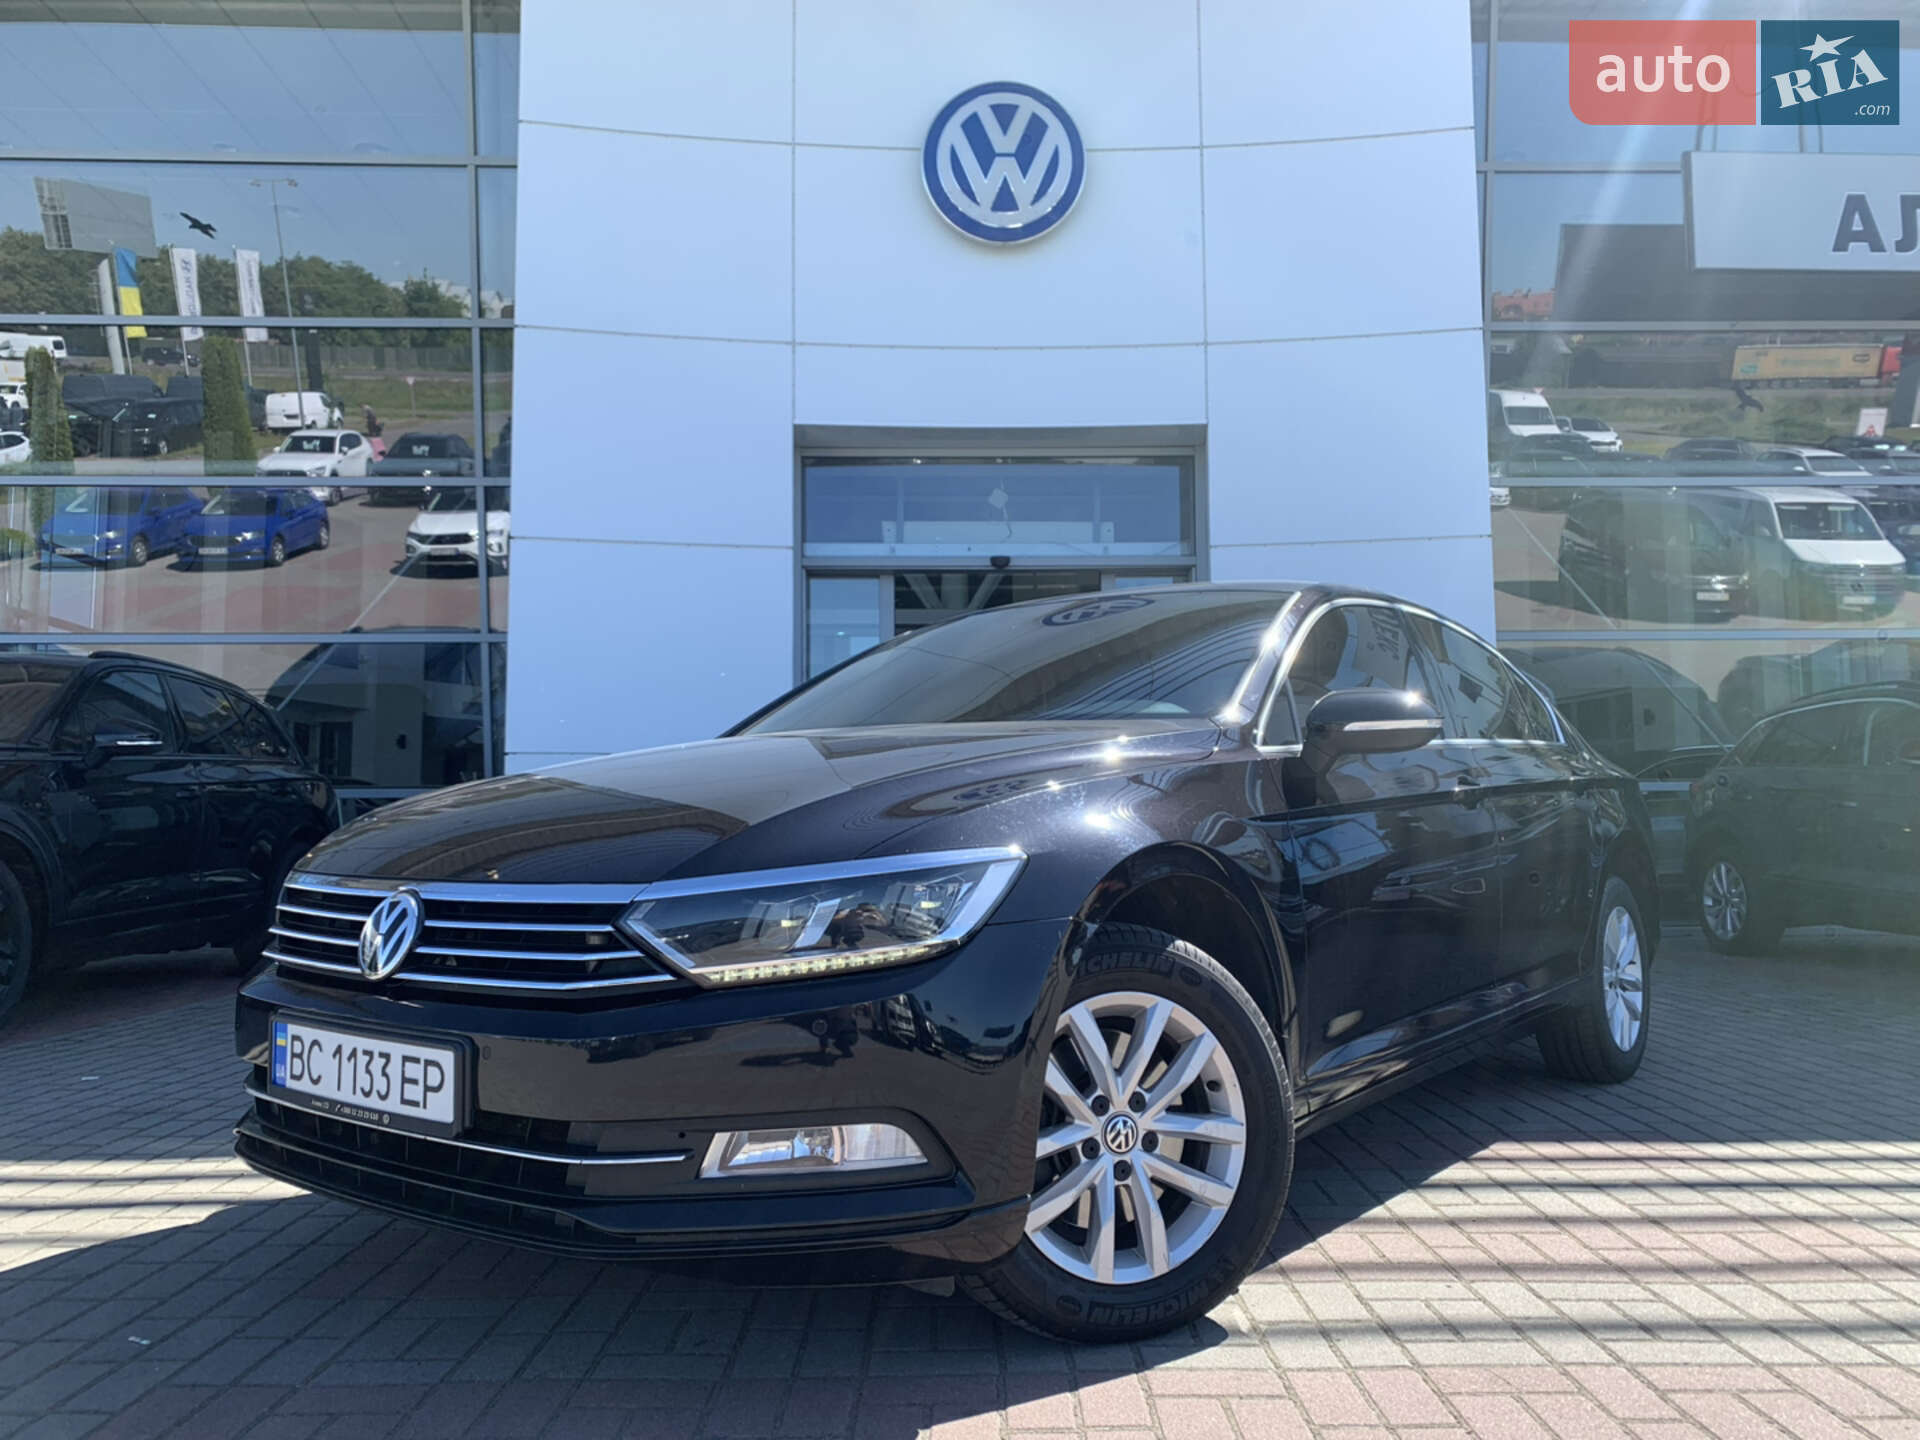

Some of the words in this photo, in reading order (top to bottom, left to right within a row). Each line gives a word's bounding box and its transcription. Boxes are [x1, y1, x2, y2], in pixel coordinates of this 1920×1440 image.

[1078, 951, 1176, 978] ICHELIN
[290, 1034, 323, 1086] BC
[332, 1043, 392, 1102] 1133
[400, 1055, 445, 1110] EP
